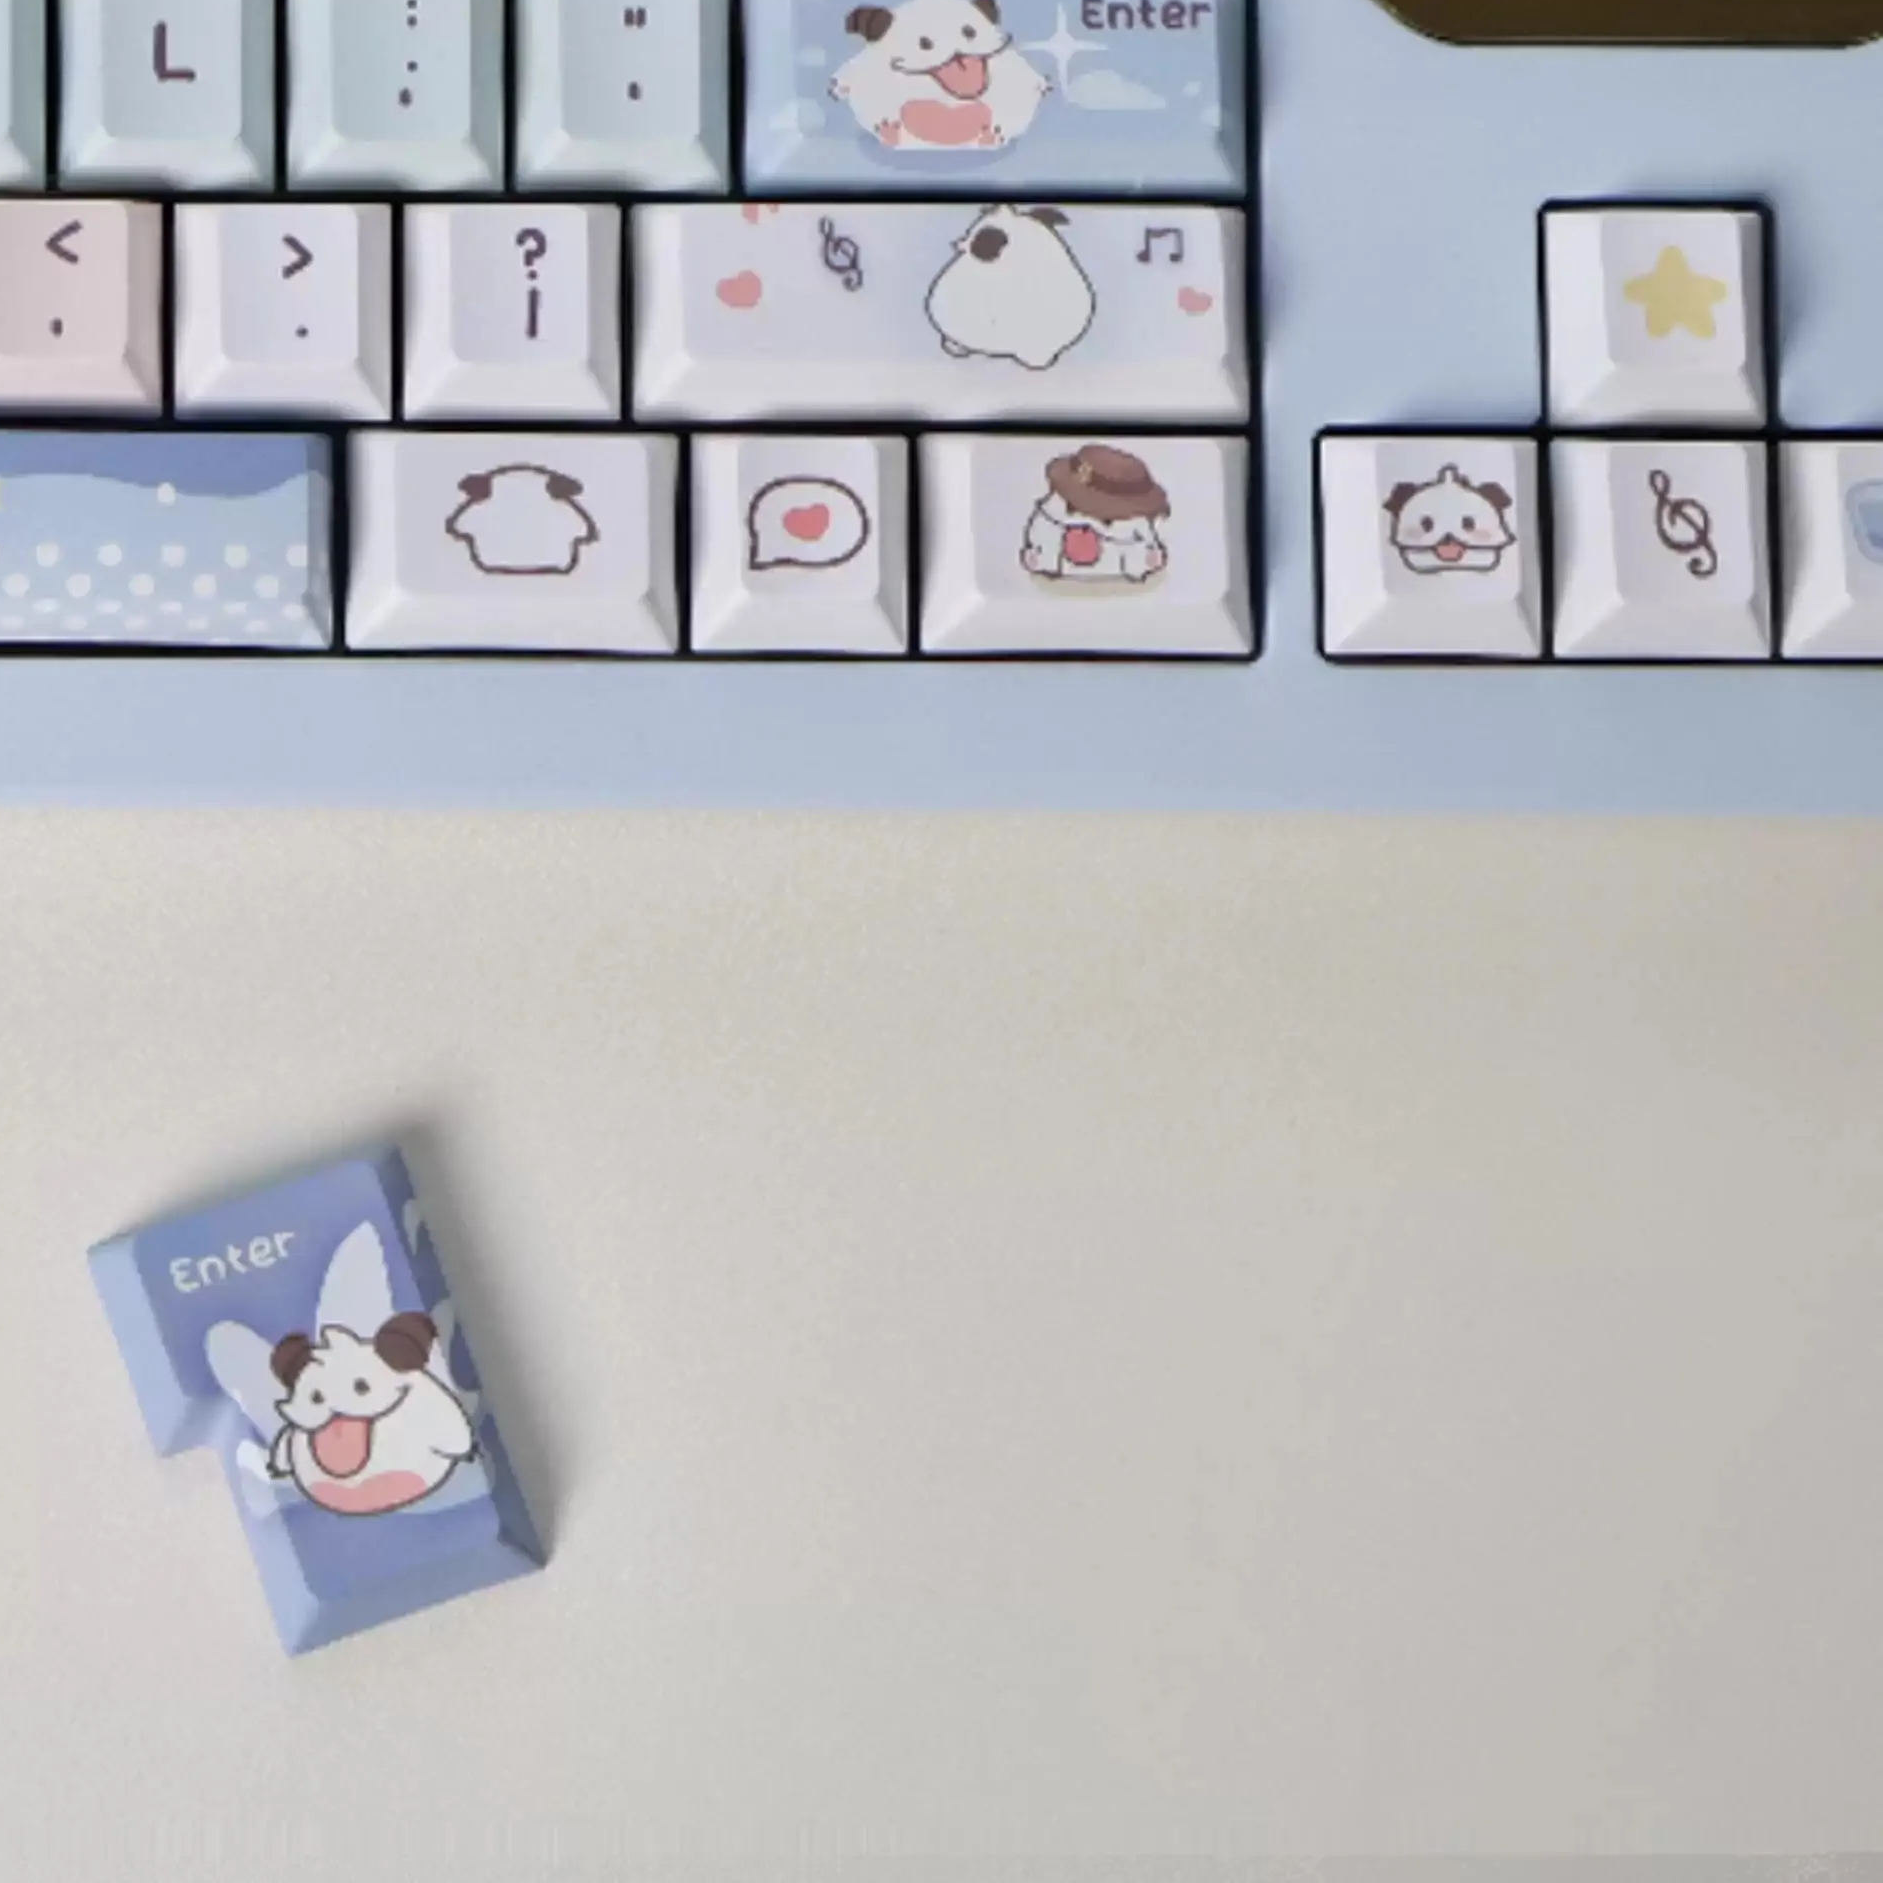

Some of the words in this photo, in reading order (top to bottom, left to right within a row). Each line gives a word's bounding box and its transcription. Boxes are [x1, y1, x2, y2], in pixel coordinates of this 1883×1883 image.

[407, 0, 417, 27] :
[624, 8, 646, 28] "
[153, 22, 196, 82] L
[399, 61, 417, 107] ;
[46, 221, 82, 263] <
[283, 236, 312, 278] >
[516, 228, 546, 280] ?
[170, 1232, 295, 1292] Enter
